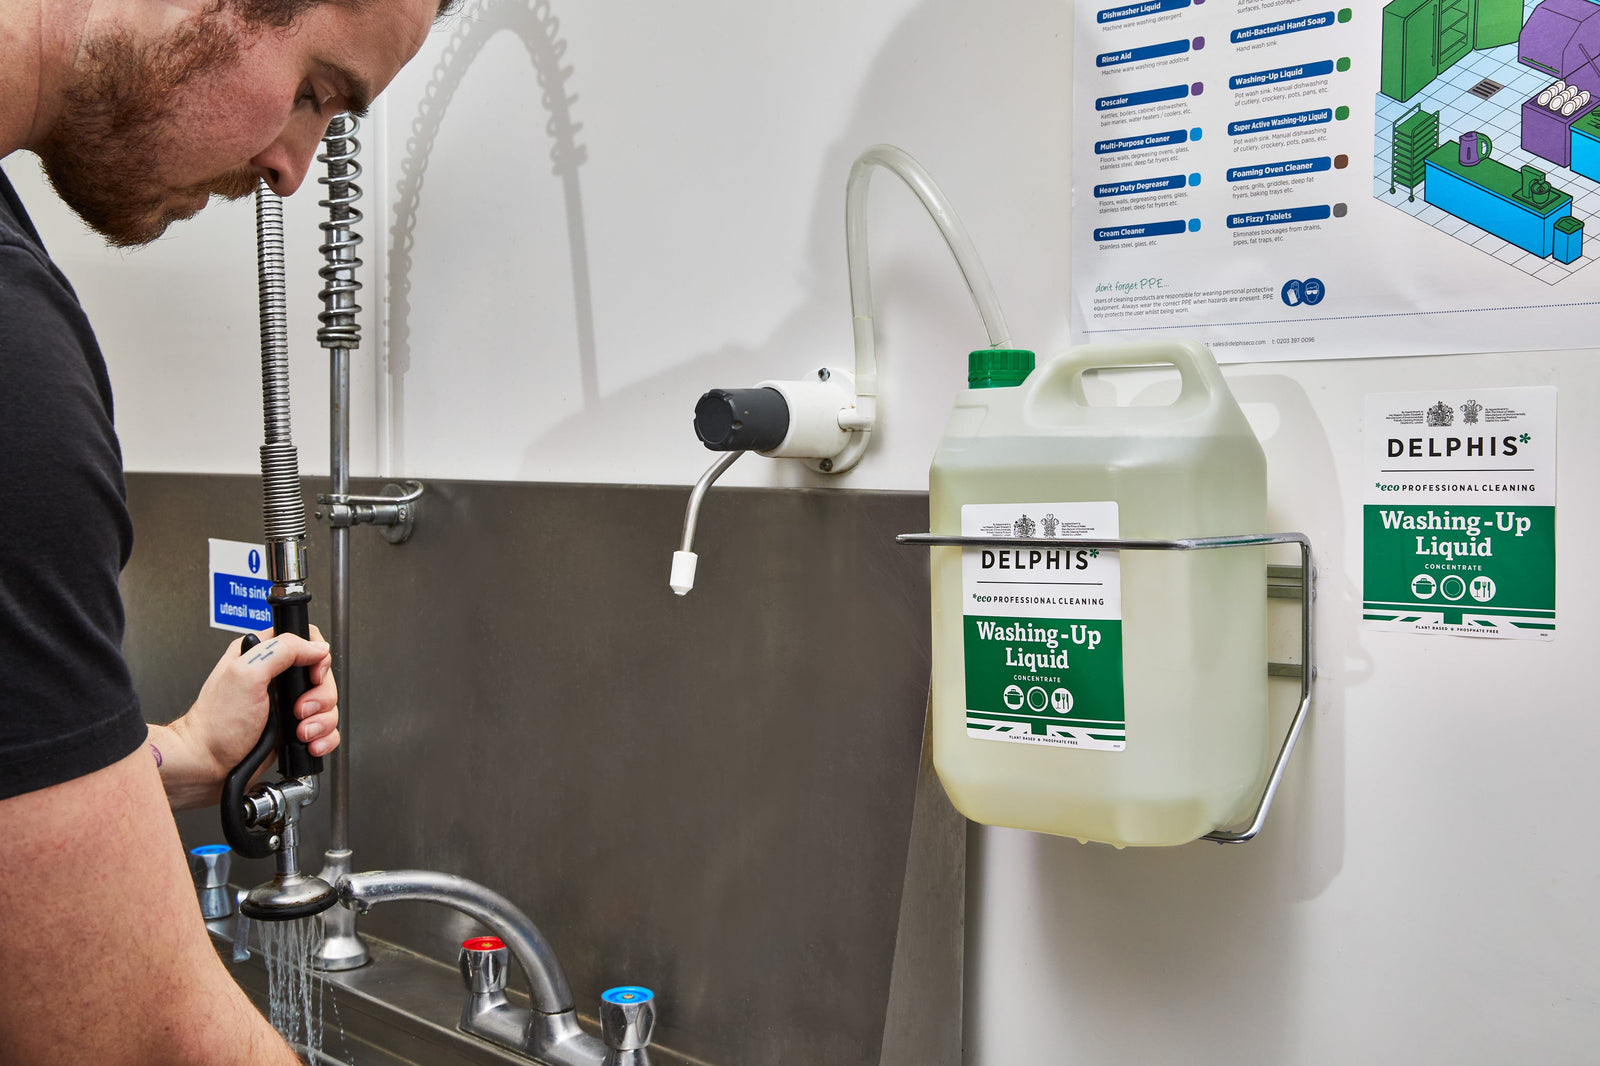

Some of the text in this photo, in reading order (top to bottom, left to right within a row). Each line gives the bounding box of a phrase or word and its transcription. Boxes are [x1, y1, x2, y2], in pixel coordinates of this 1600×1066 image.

[1102, 3, 1161, 19] Dishwasher Liquid
[1157, 13, 1182, 22] detergent
[1237, 19, 1326, 39] Anti-Bacterial Hand Soap
[1236, 44, 1250, 52] Hand
[1120, 52, 1131, 60] Aid
[1236, 68, 1303, 85] Washing-Up Liquid
[1273, 84, 1292, 92] Manual
[1294, 80, 1328, 89] dishwashing
[1101, 98, 1128, 107] Descaler
[1271, 115, 1307, 126] Washing-Up
[1308, 112, 1328, 122] Liquid
[1272, 132, 1291, 140] Manual
[1292, 129, 1326, 137] dishwashing
[1100, 140, 1144, 150] Multi-Purpose
[1233, 169, 1263, 178] Foaming
[1285, 164, 1313, 172] Cleaner
[1120, 184, 1135, 192] Duty
[1137, 181, 1169, 190] Degreaser
[1265, 213, 1292, 221] Tablets
[1115, 281, 1138, 294] forget
[1165, 292, 1193, 300] responsible
[1223, 288, 1245, 296] personal
[1246, 287, 1273, 295] protective
[1402, 484, 1479, 492] PROFESSIONAL
[1482, 484, 1535, 492] CLEANING
[1415, 536, 1493, 560] Liquid
[229, 581, 247, 597] This
[249, 586, 267, 600] sink
[993, 596, 1056, 605] PROFESSIONAL
[1059, 597, 1104, 605] CLEANING
[220, 603, 271, 622] utensil wash
[1005, 647, 1069, 672] Liquid
[1013, 675, 1061, 683] CONCENTRATE
